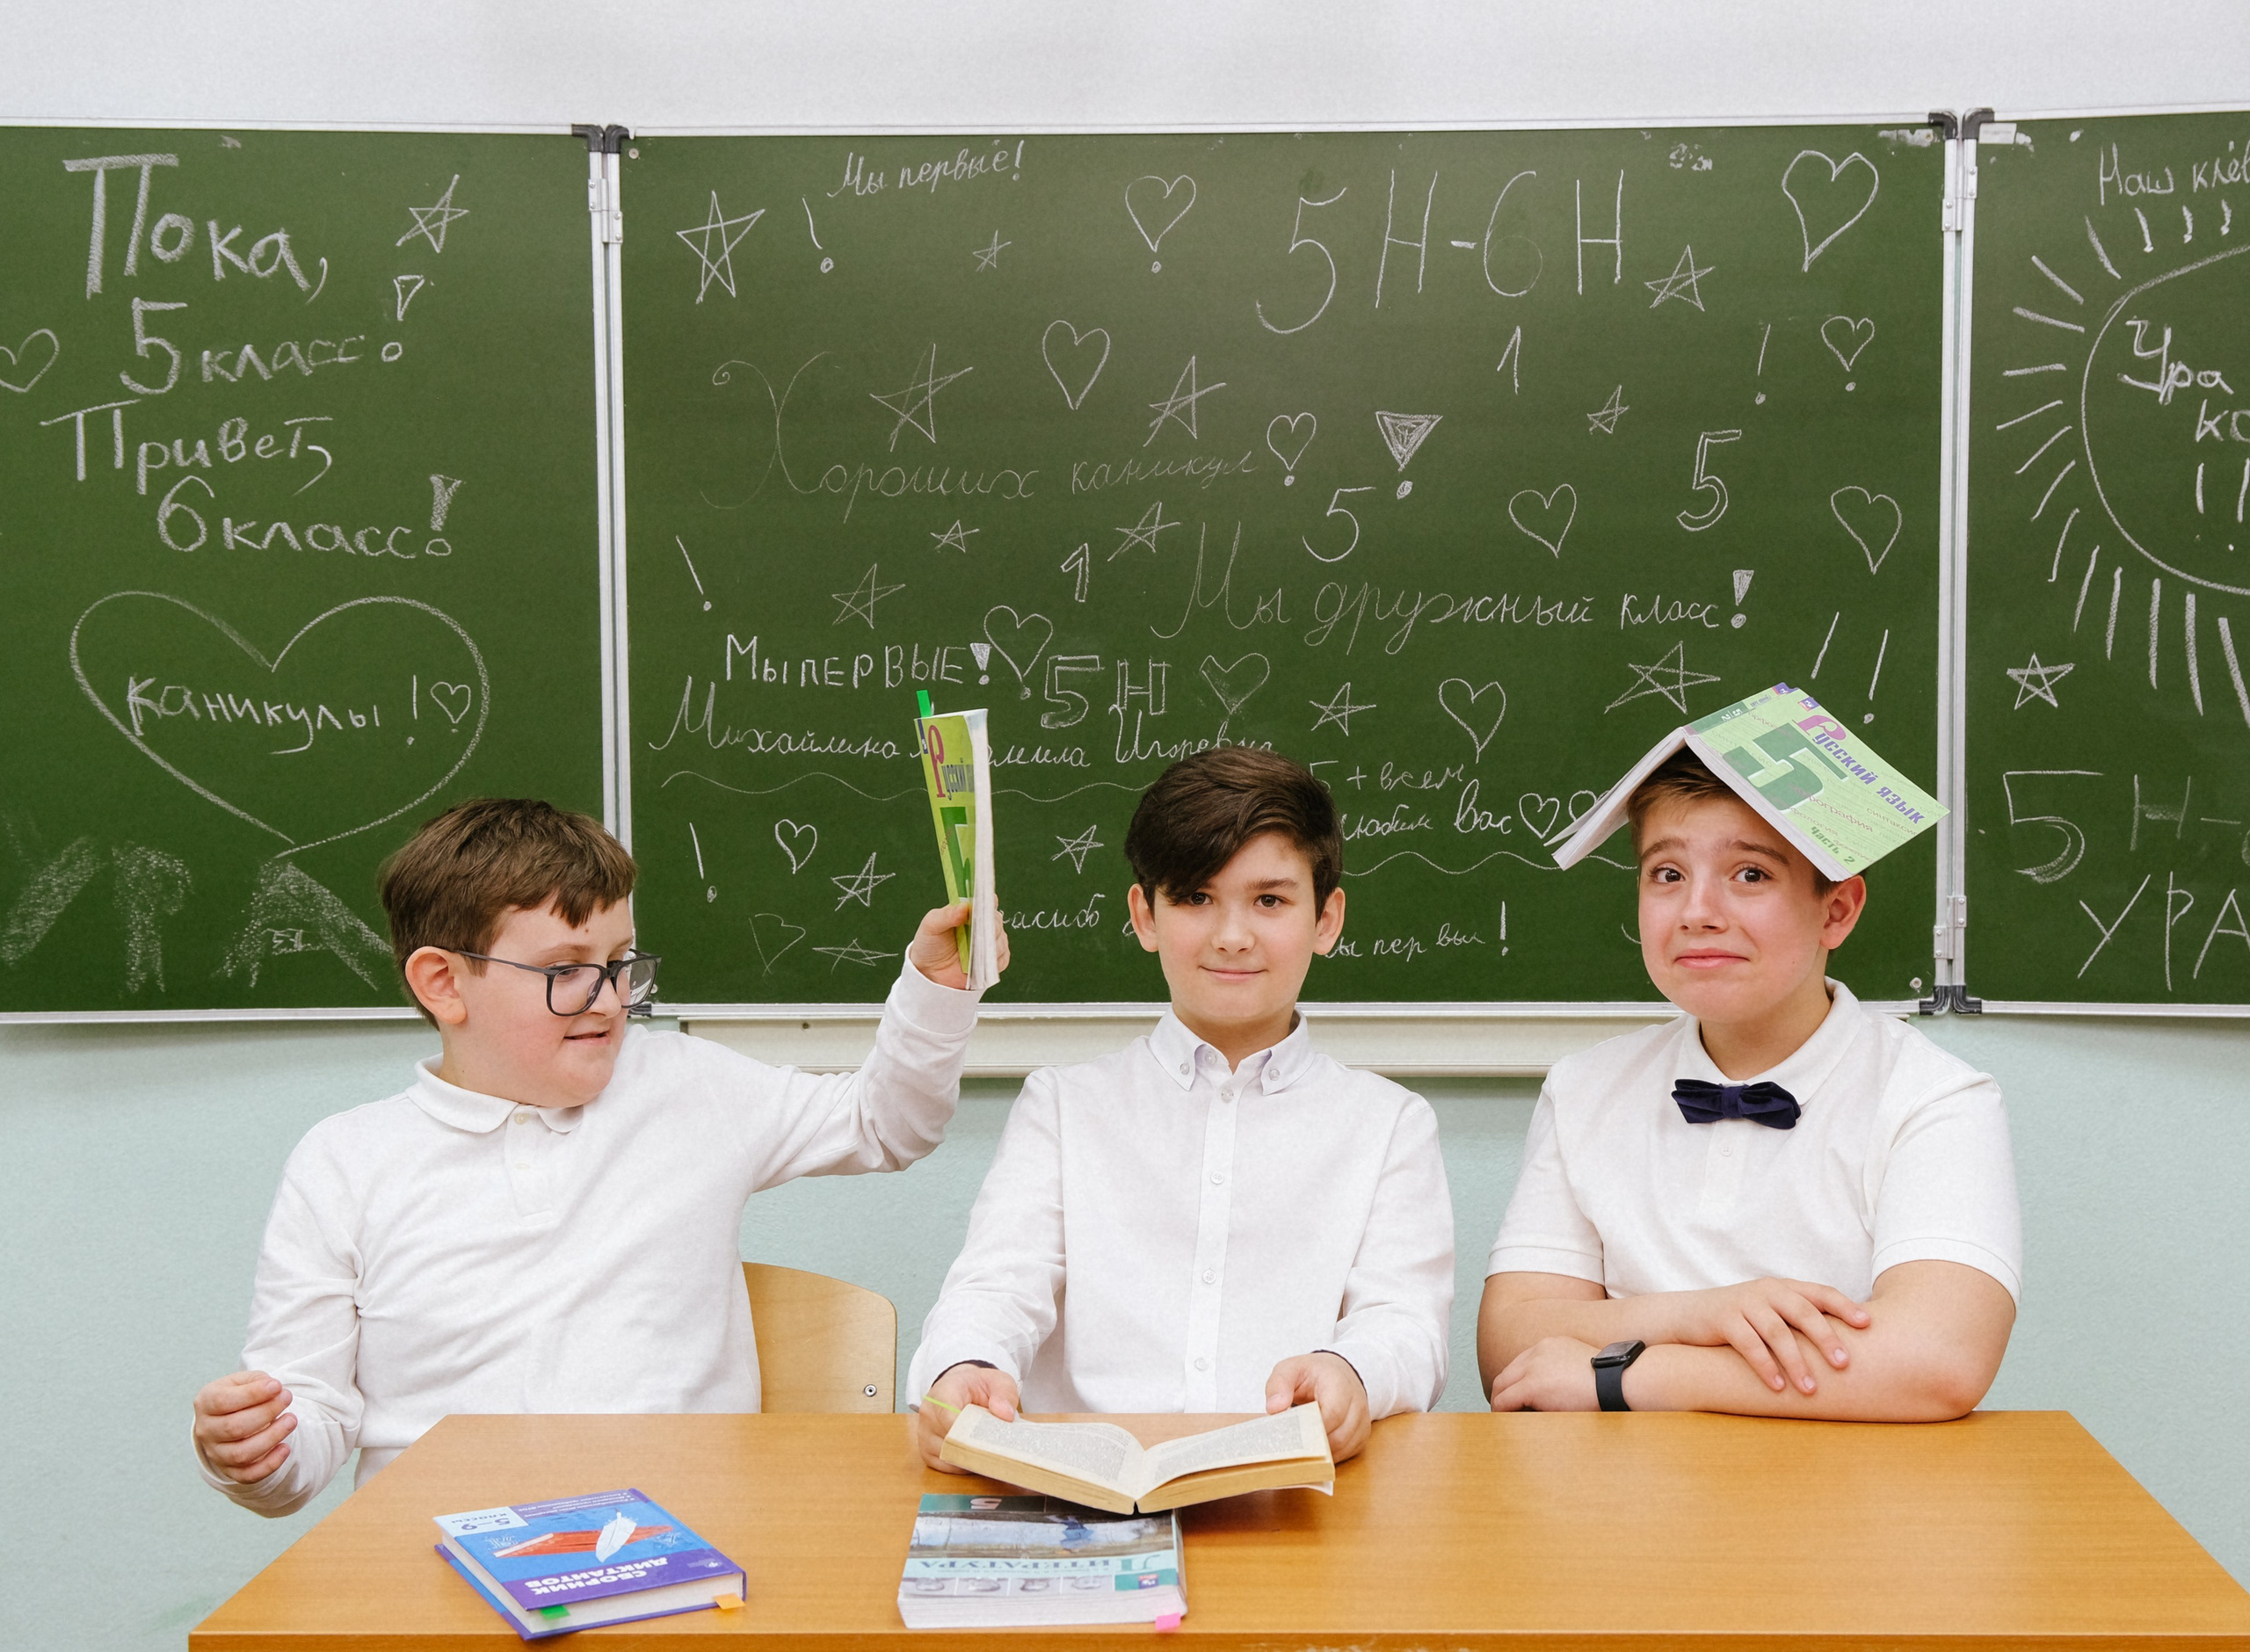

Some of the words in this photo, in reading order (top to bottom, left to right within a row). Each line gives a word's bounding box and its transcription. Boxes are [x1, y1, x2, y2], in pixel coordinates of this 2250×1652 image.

[826, 151, 888, 198] Мы
[2099, 142, 2174, 206] Наш
[63, 153, 328, 305] Пока,
[120, 296, 188, 395] 5
[700, 351, 1041, 525] Хороших
[1676, 428, 1743, 533] 5
[1149, 523, 1292, 640] Мы
[1303, 580, 1596, 656] дружный
[1722, 721, 1850, 814] 5
[1791, 714, 1879, 786] Русский
[1875, 786, 1926, 825] язык
[969, 1496, 1003, 1511] 5
[524, 1556, 670, 1588] ДИКТАНТОВ
[533, 1569, 649, 1597] СБОРНИК
